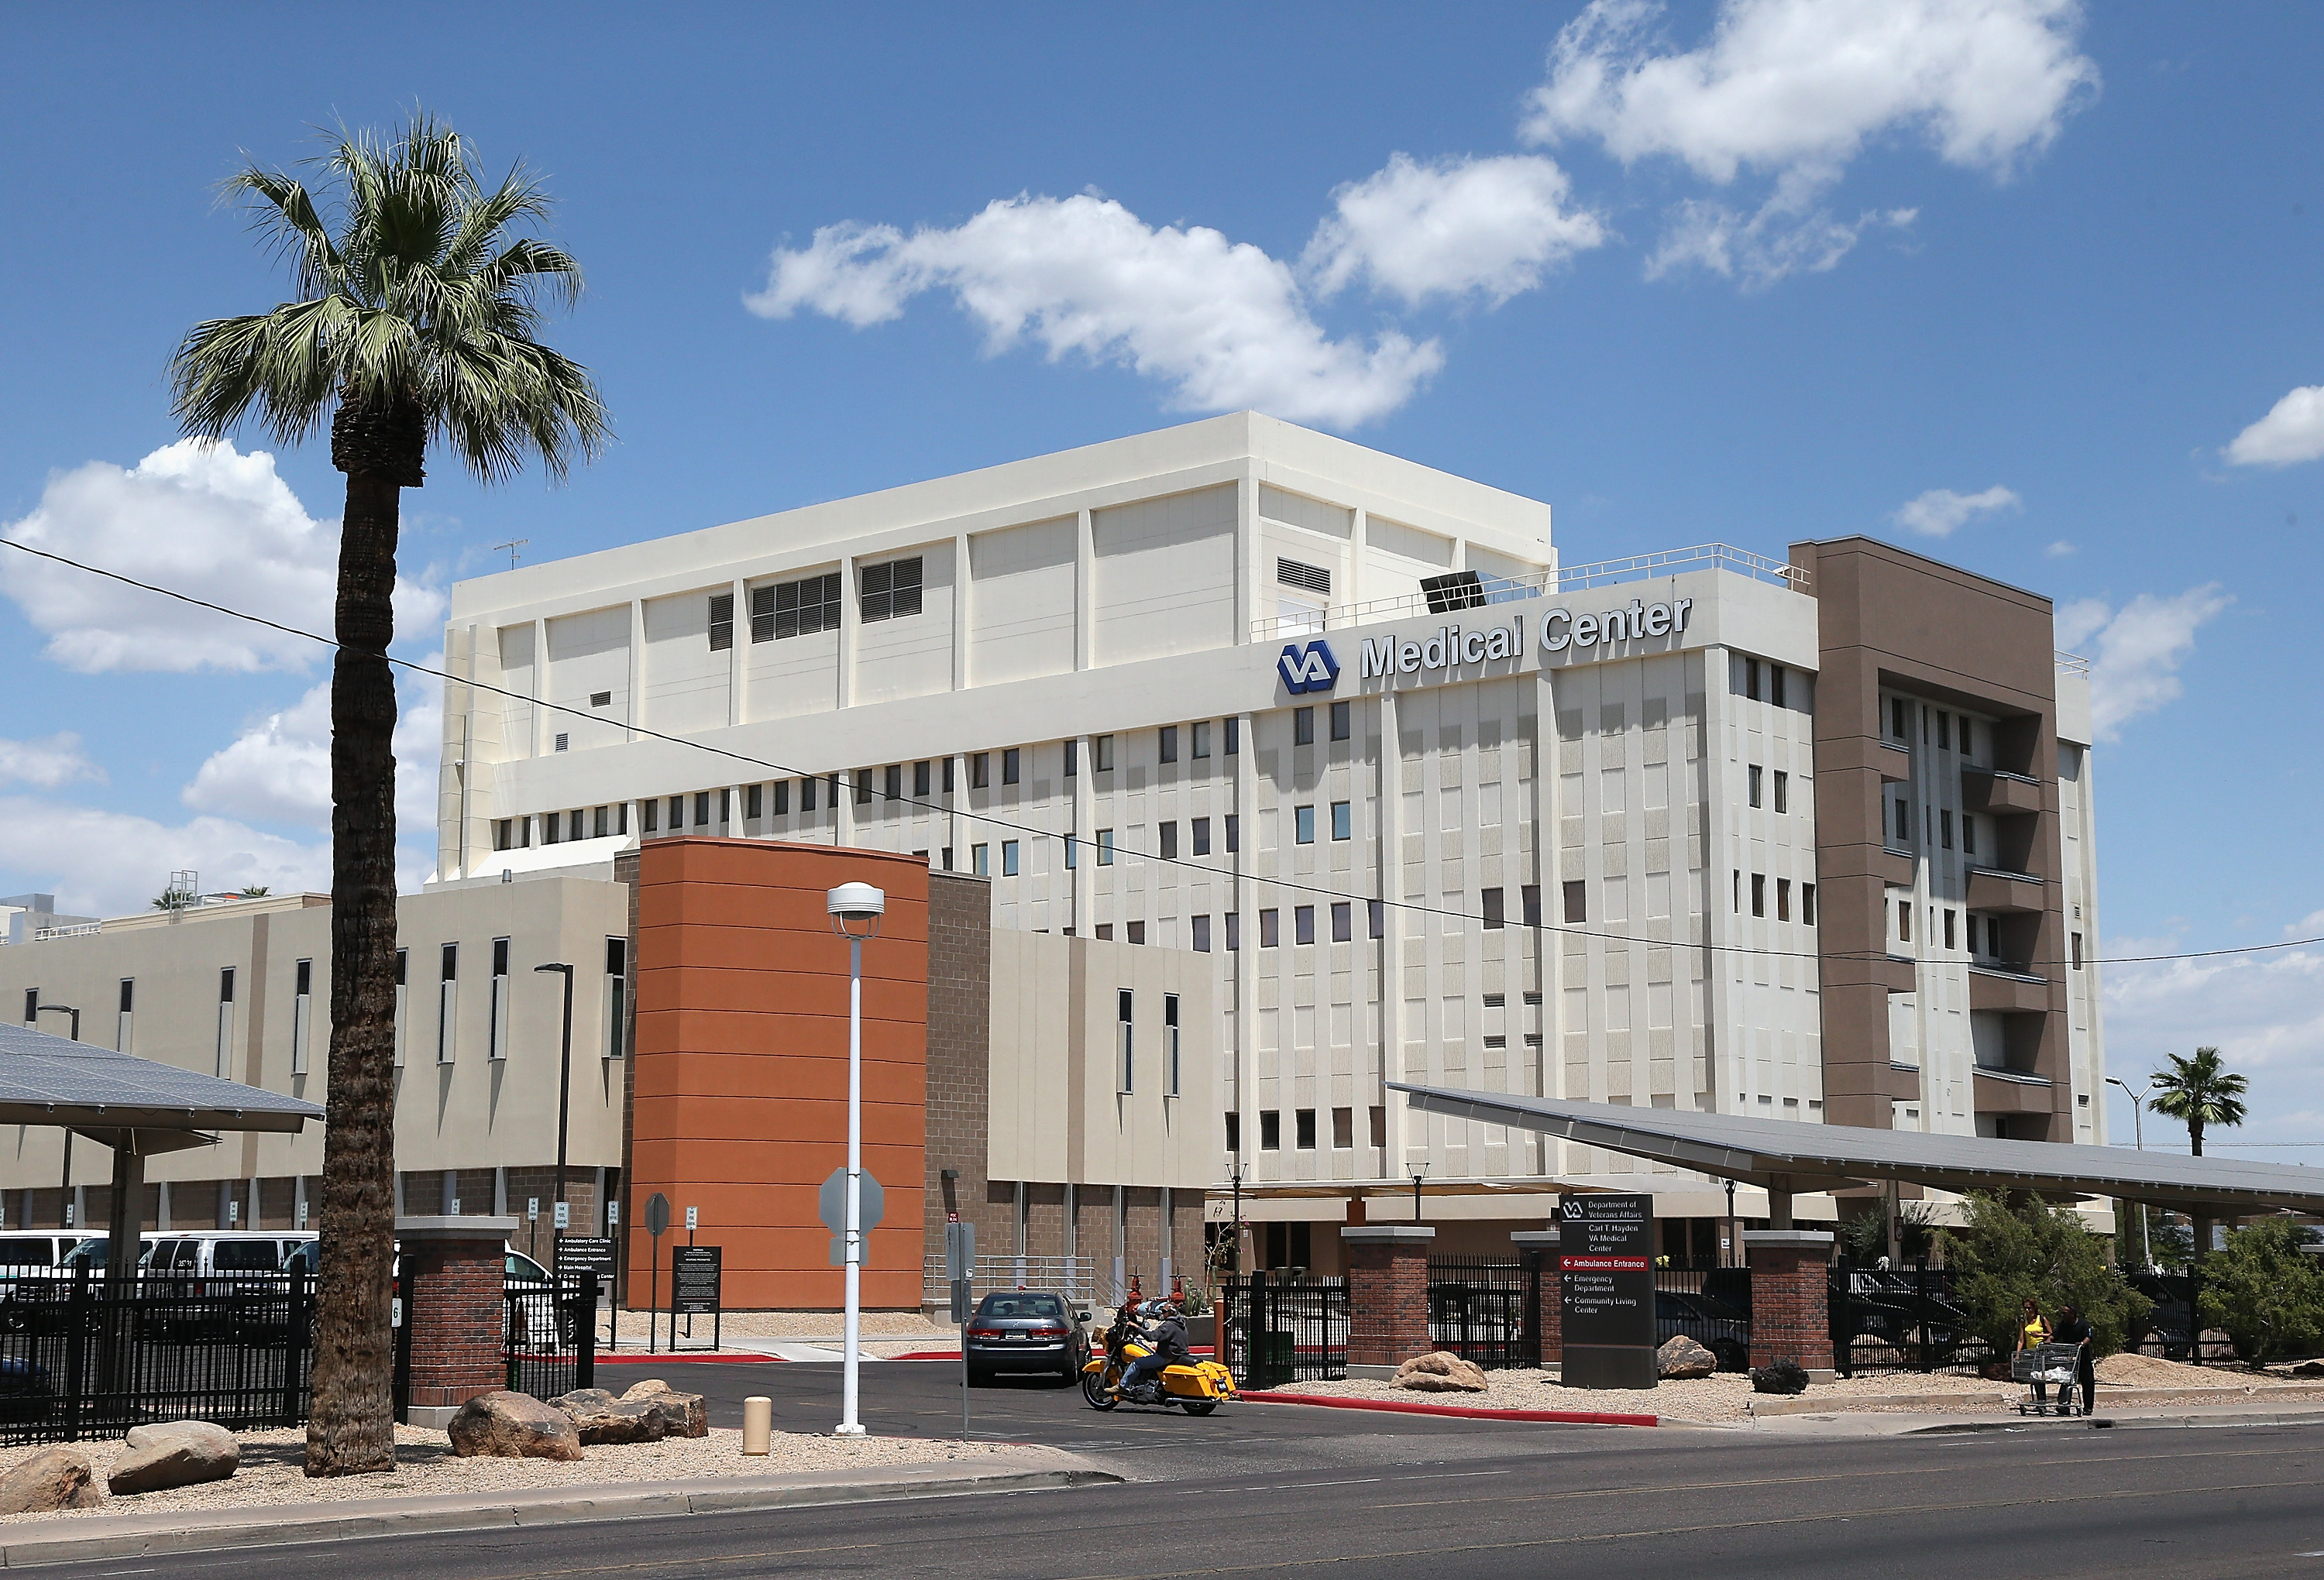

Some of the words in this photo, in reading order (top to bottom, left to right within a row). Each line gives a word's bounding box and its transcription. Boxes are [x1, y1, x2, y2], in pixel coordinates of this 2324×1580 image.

[1361, 615, 1524, 679] Medical
[1539, 597, 1692, 652] Center
[1563, 1201, 1583, 1218] VA
[1588, 1201, 1628, 1210] Department
[1612, 1224, 1638, 1233] Hayden
[1574, 1275, 1612, 1283] Emergency
[1574, 1284, 1614, 1293] Department
[1575, 1297, 1614, 1306] Community
[1615, 1297, 1636, 1307] Living
